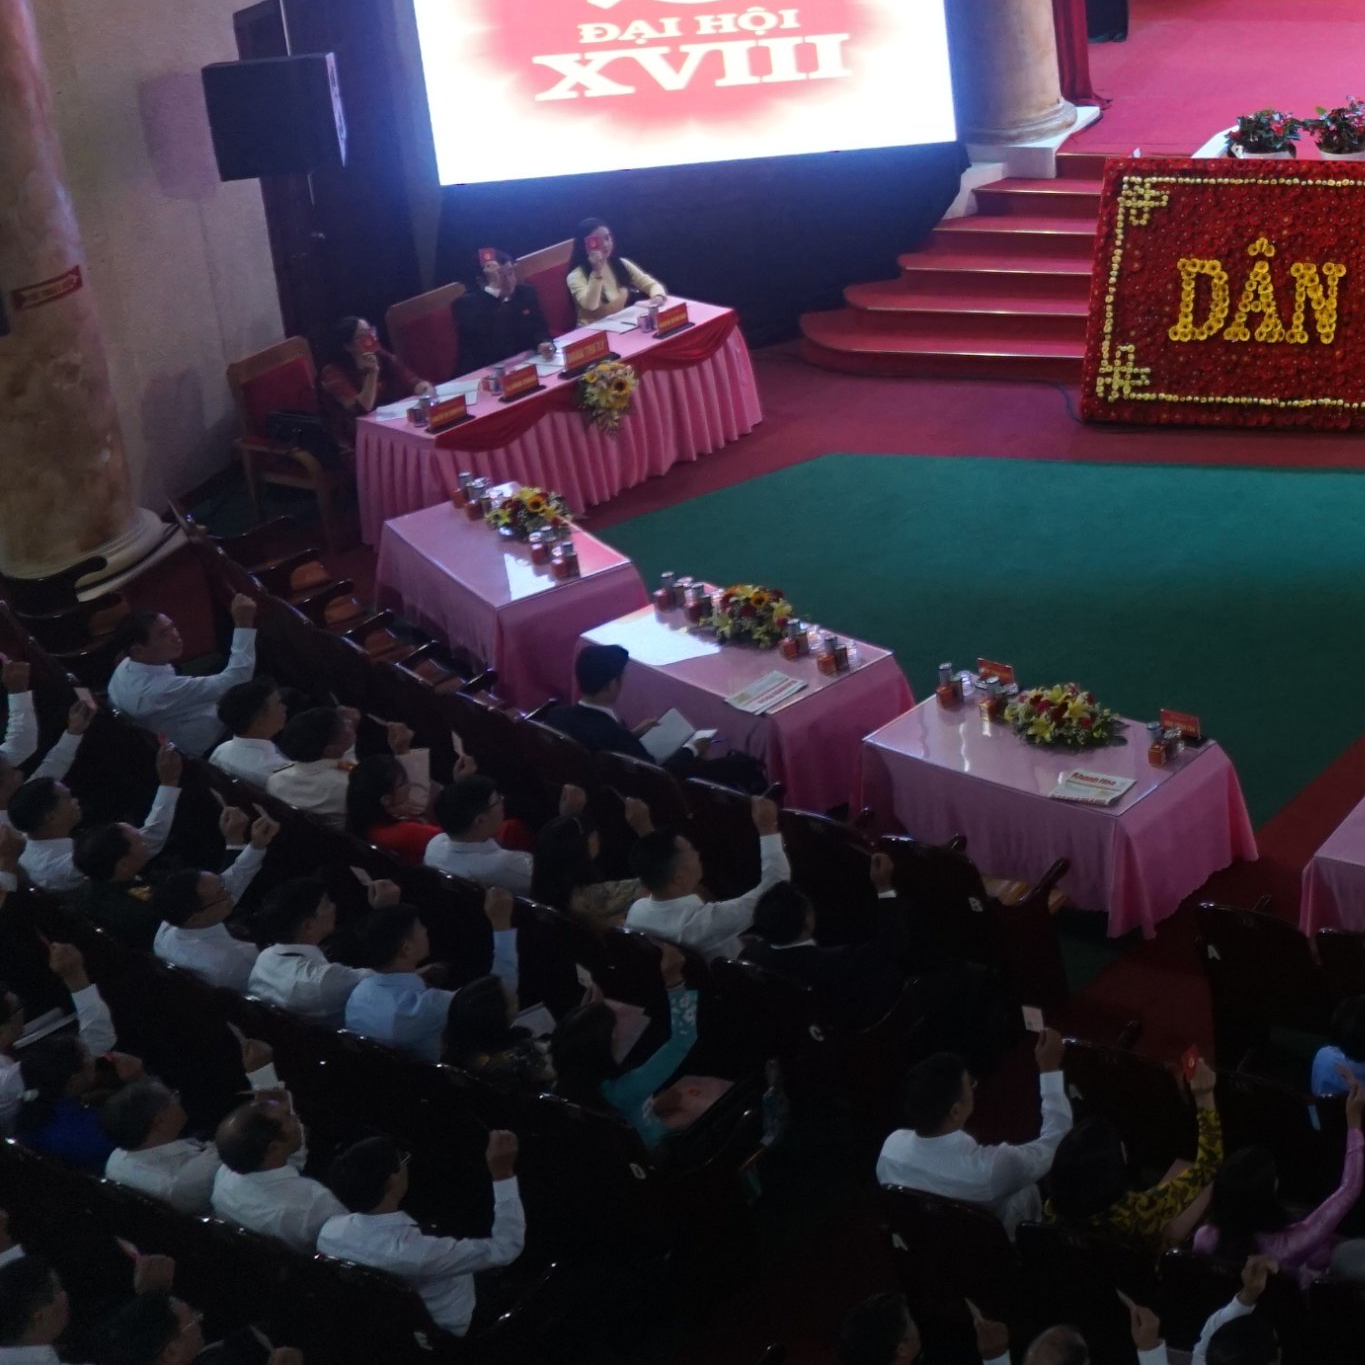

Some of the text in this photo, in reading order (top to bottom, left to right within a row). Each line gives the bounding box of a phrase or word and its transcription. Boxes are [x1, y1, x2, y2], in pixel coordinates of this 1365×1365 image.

[577, 7, 801, 45] ĐẠI HỘI
[532, 33, 853, 101] XVIII
[1166, 236, 1346, 345] DÂN
